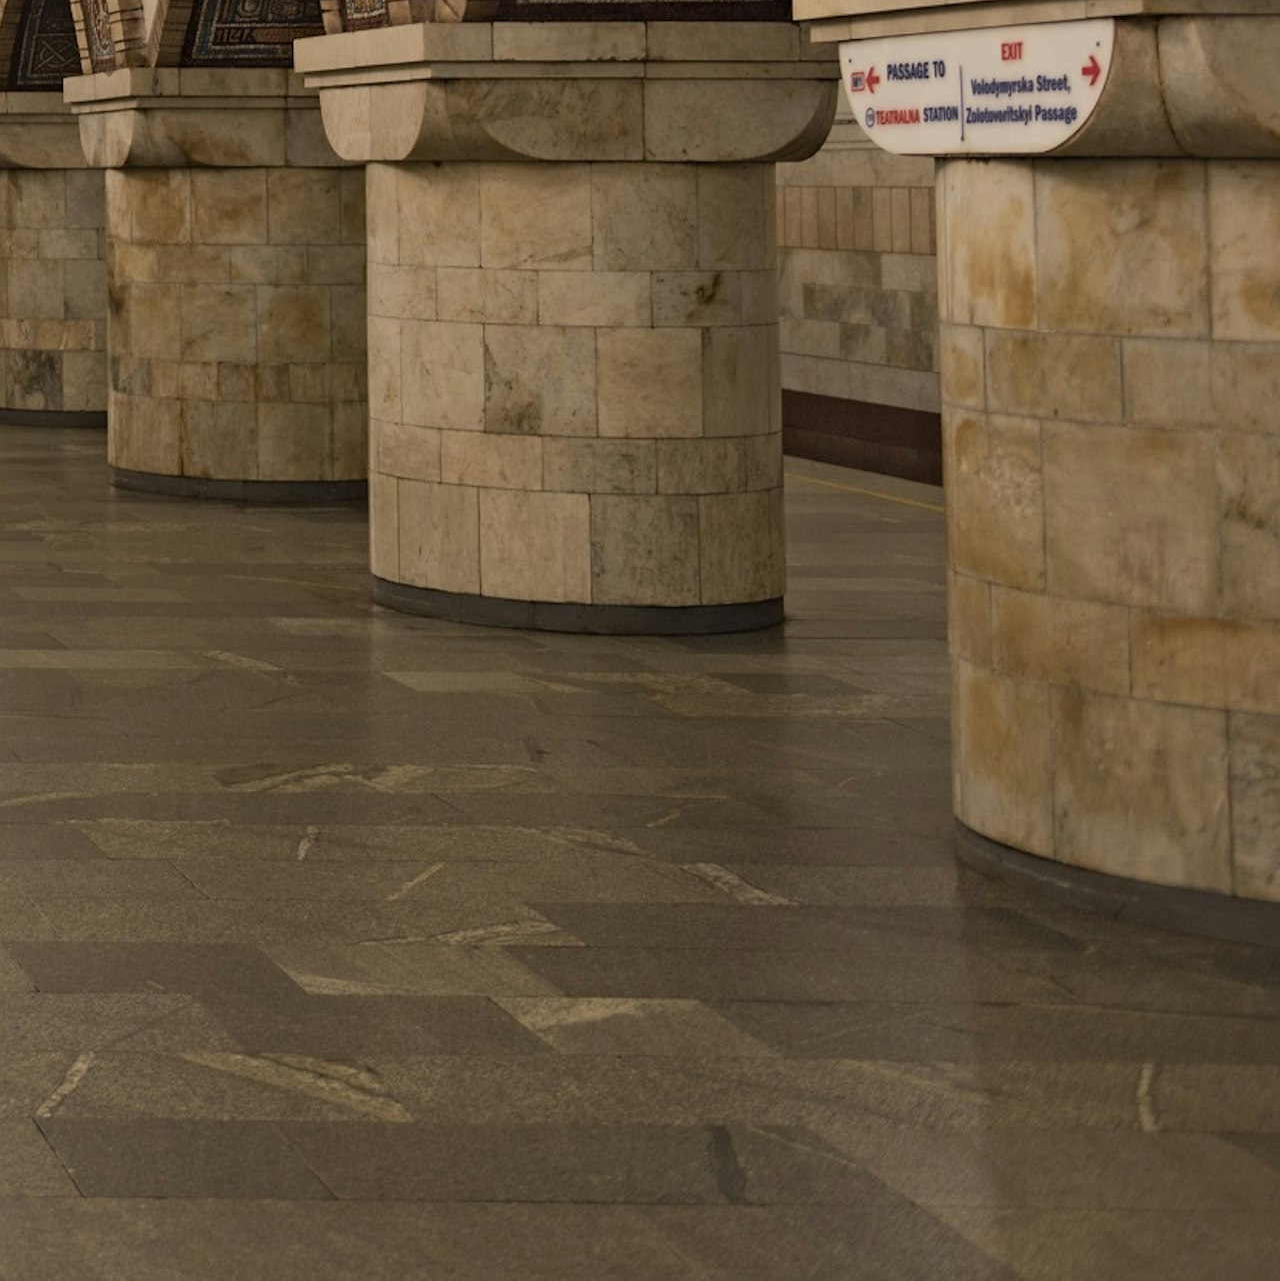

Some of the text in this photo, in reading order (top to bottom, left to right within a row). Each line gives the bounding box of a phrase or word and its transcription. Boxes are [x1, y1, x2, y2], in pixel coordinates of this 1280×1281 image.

[1001, 42, 1023, 61] EXIT
[887, 61, 930, 80] PASSAGE
[933, 60, 945, 78] TO
[970, 74, 1071, 98] Volodymyrska Street,
[876, 109, 920, 125] TEATRALNA
[923, 106, 958, 122] STATION
[1035, 105, 1077, 125] Passage
